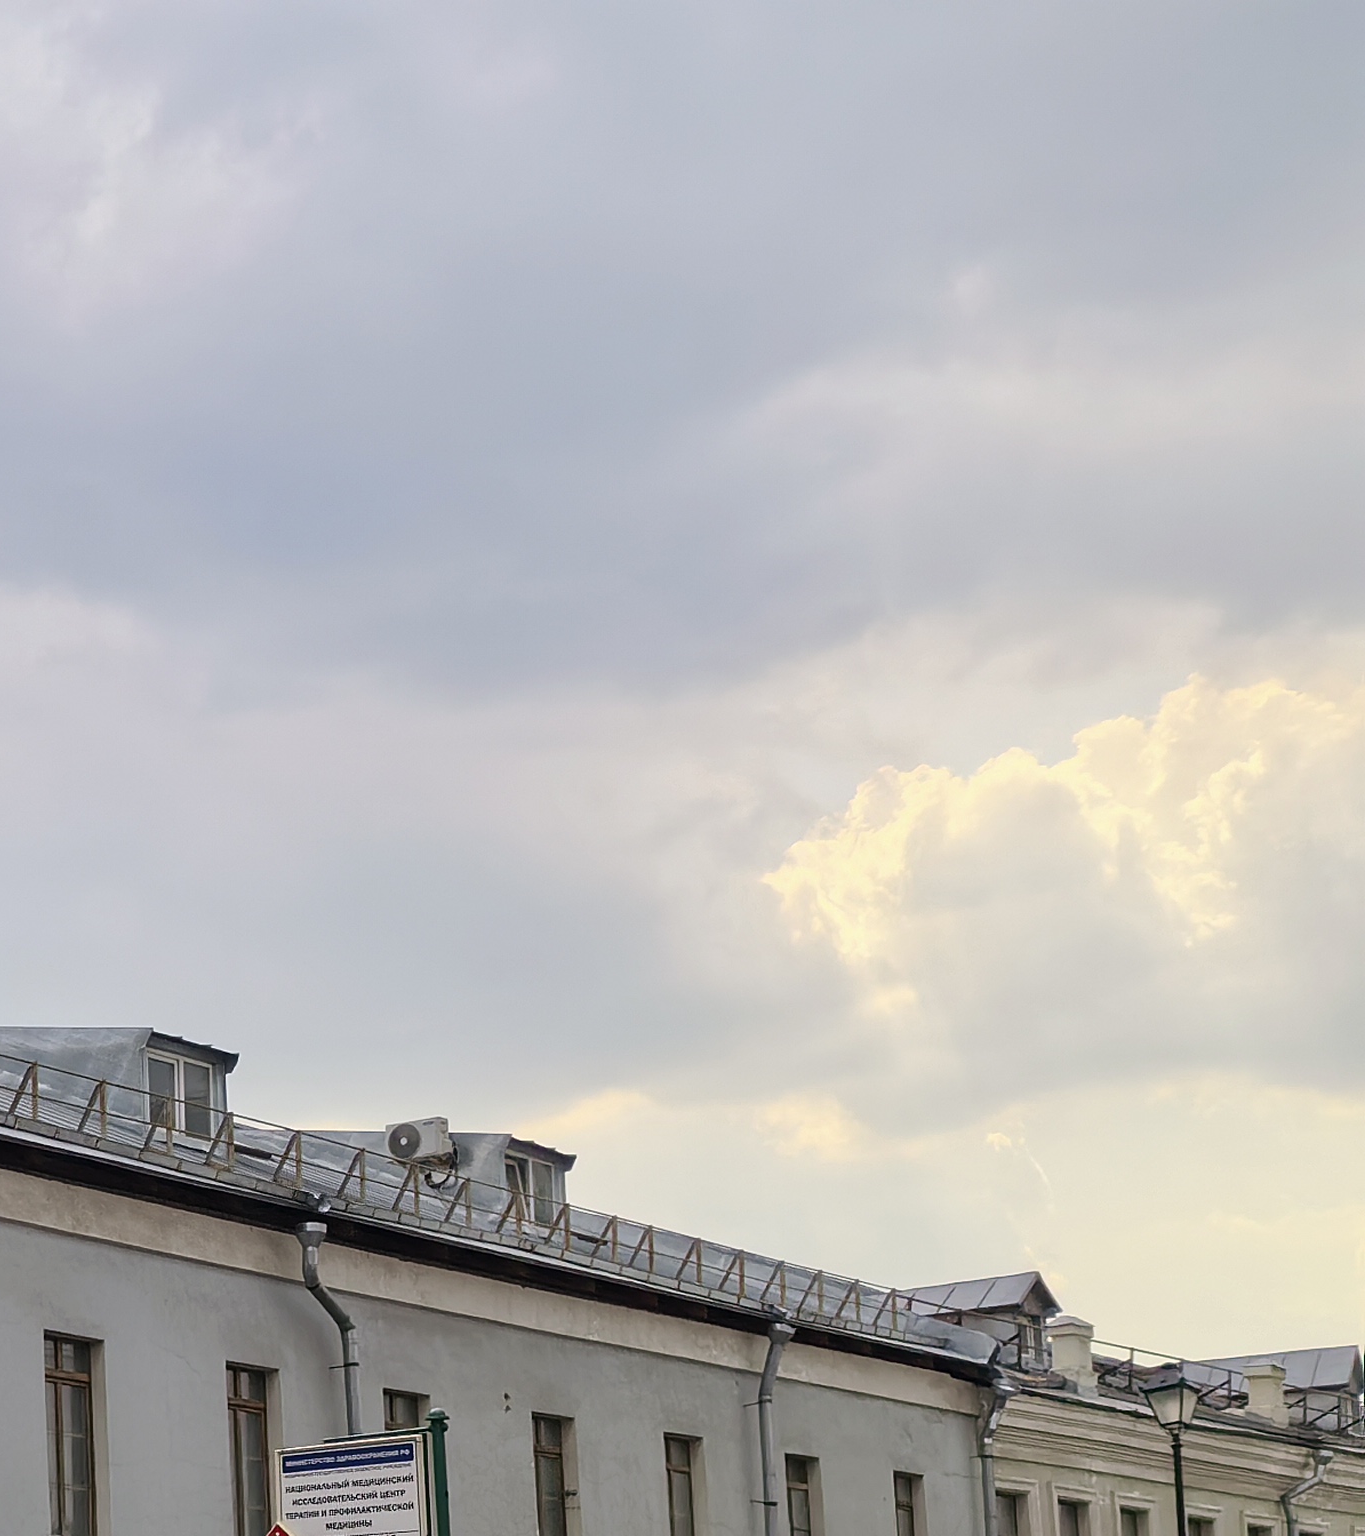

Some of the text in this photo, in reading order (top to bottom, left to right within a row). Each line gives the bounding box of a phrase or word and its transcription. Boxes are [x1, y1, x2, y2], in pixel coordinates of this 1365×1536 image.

[399, 1448, 411, 1457] РФ
[285, 1473, 414, 1494] НАЦИОНАЛЬНЫЙ МЕДИЦИНСКИЙ
[292, 1489, 406, 1507] ИССЛЕДОВАТЕЛЬСКИЙ ЦЕНТР
[285, 1501, 415, 1520] ТЕРАПИИ И ПРОФИЛАКТИЧЕСКОЙ
[325, 1519, 373, 1531] МЕДИЦИНЫ
